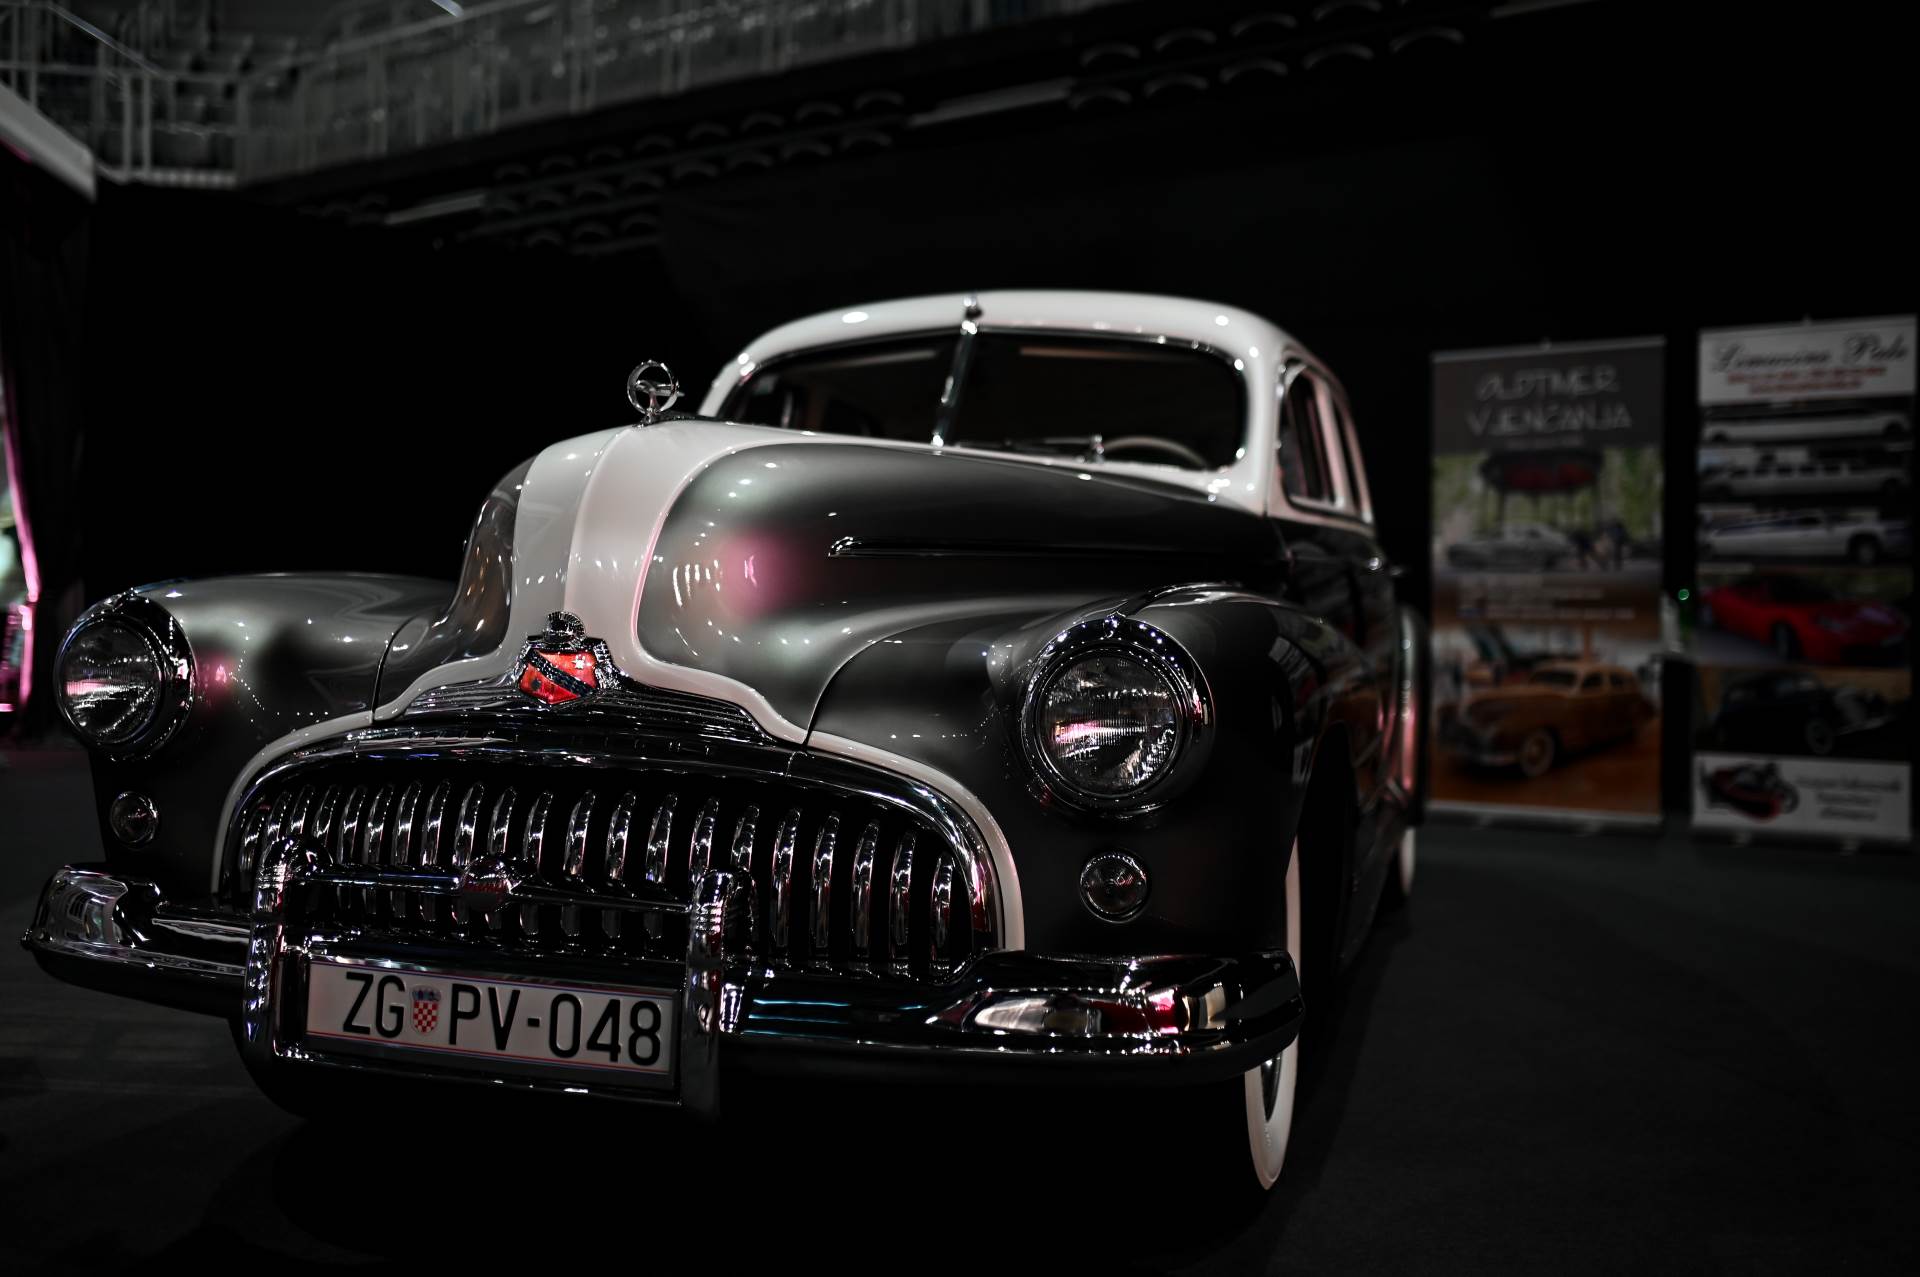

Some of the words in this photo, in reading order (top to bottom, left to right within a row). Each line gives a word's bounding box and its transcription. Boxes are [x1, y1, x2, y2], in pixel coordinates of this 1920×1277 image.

[1476, 363, 1621, 402] OLDTIMER
[343, 971, 406, 1038] ZG
[449, 983, 662, 1067] PV-048
